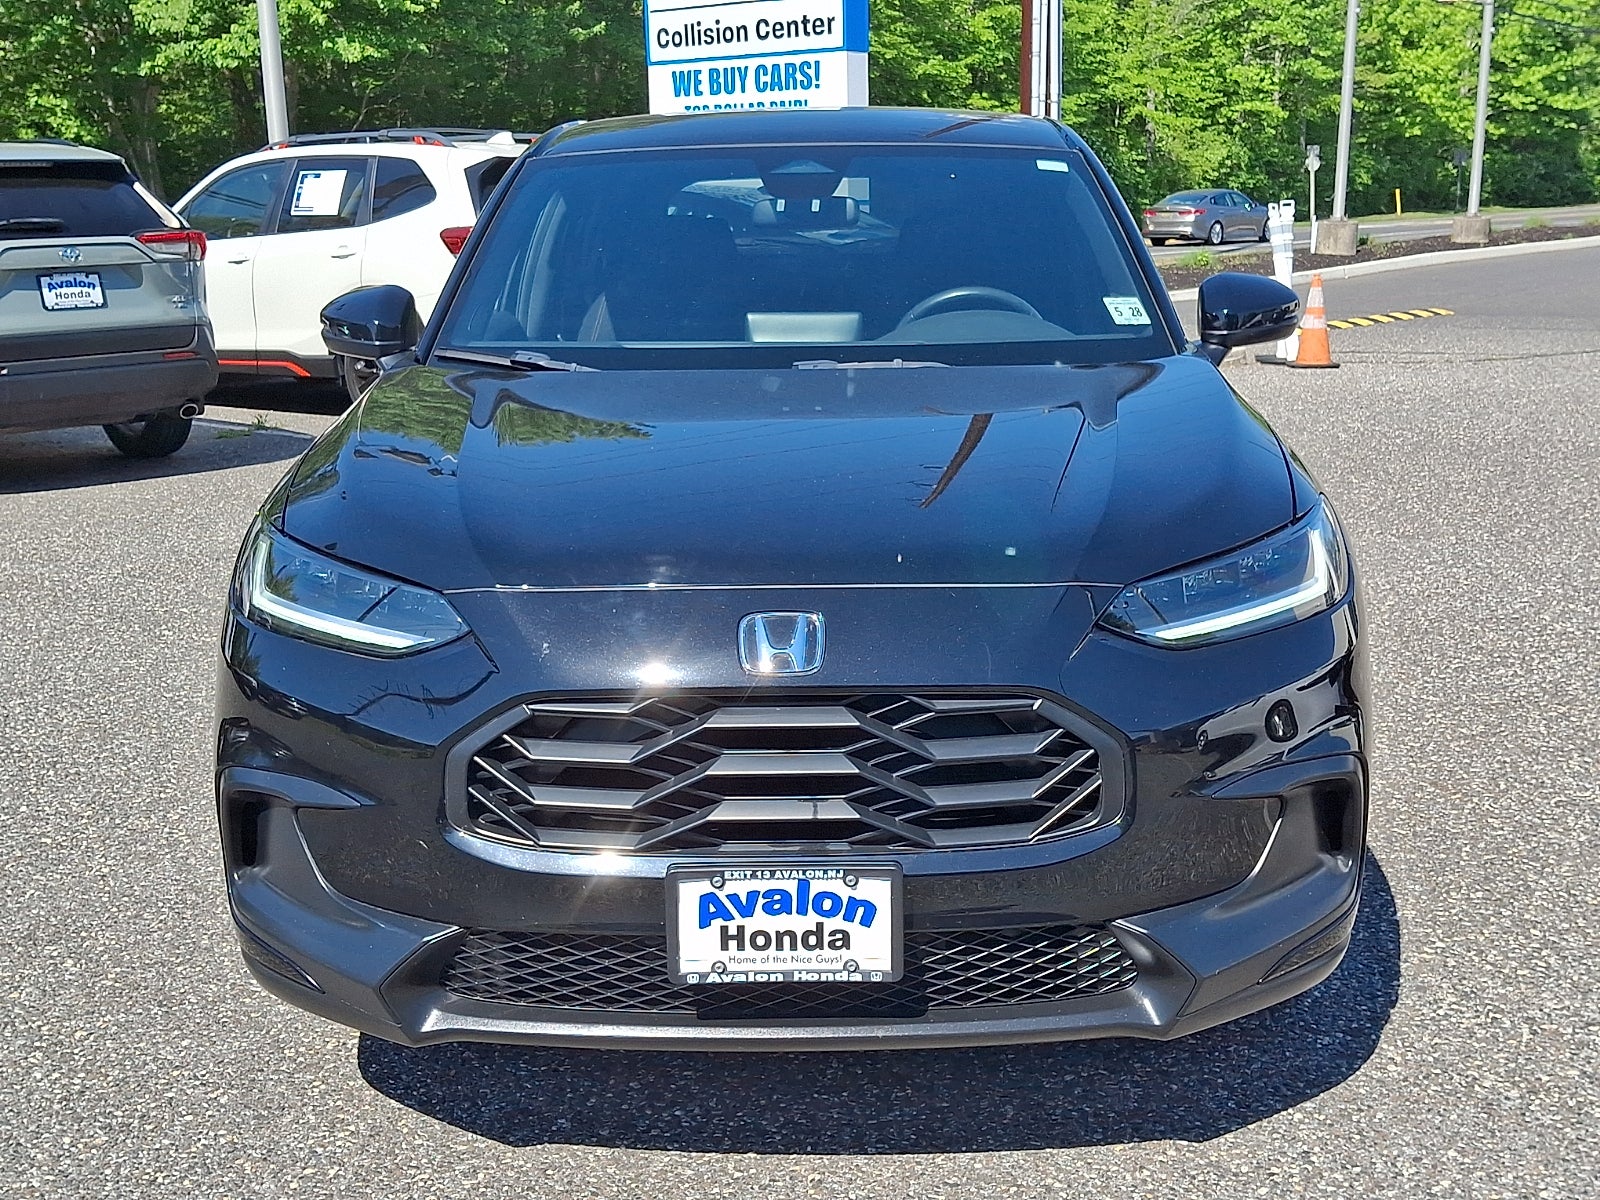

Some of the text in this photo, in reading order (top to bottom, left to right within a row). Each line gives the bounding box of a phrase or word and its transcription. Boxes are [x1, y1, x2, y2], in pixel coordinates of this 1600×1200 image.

[656, 14, 836, 49] Collision Center
[671, 60, 821, 97] WE BUY CARS!
[47, 277, 97, 293] Avalon
[54, 289, 92, 300] Honda
[1114, 306, 1143, 317] 5 28
[724, 870, 753, 880] EXIT
[755, 870, 771, 880] 13
[698, 878, 878, 930] Avalon
[719, 921, 851, 951] Honda
[728, 954, 843, 966] Home of the Nice Guys!
[705, 970, 863, 983] Avalon Honda
